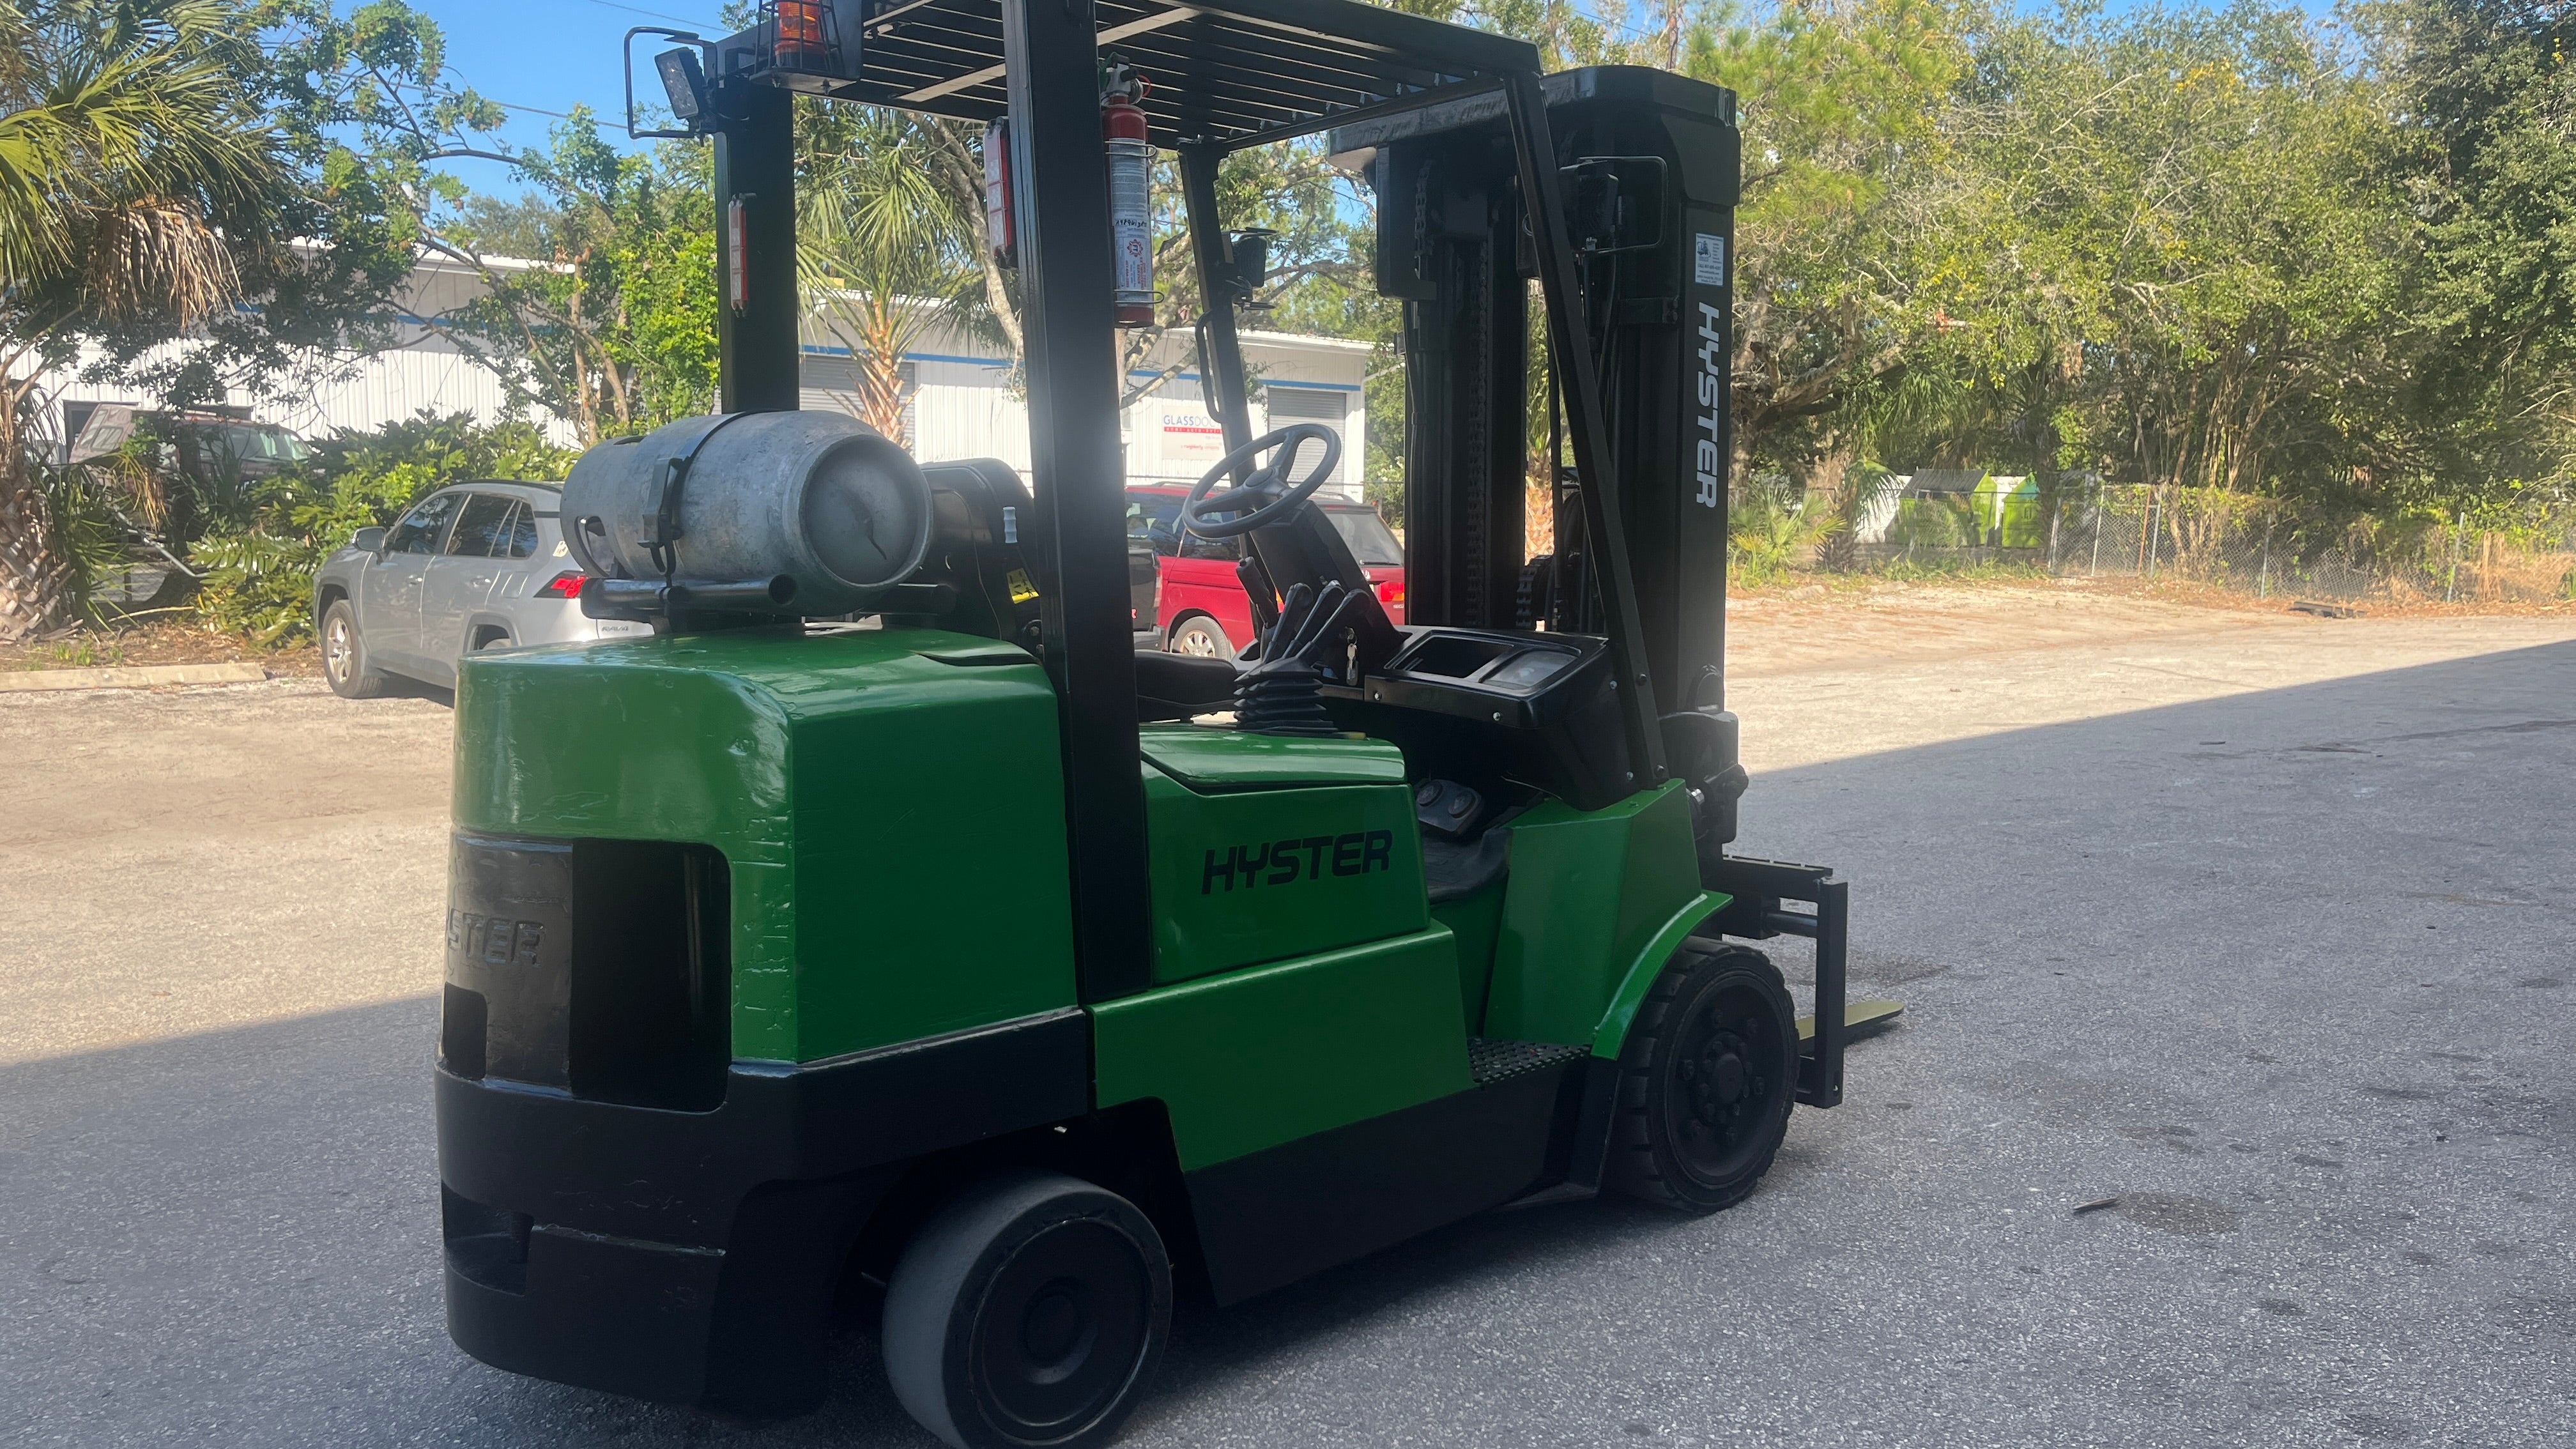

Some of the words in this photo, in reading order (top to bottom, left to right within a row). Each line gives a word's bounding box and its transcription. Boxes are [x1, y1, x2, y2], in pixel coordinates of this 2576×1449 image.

[1163, 415, 1220, 427] GLASSDOC
[1696, 302, 1720, 509] HYSTER
[1201, 829, 1393, 895] HYSTER
[447, 908, 546, 969] STER
